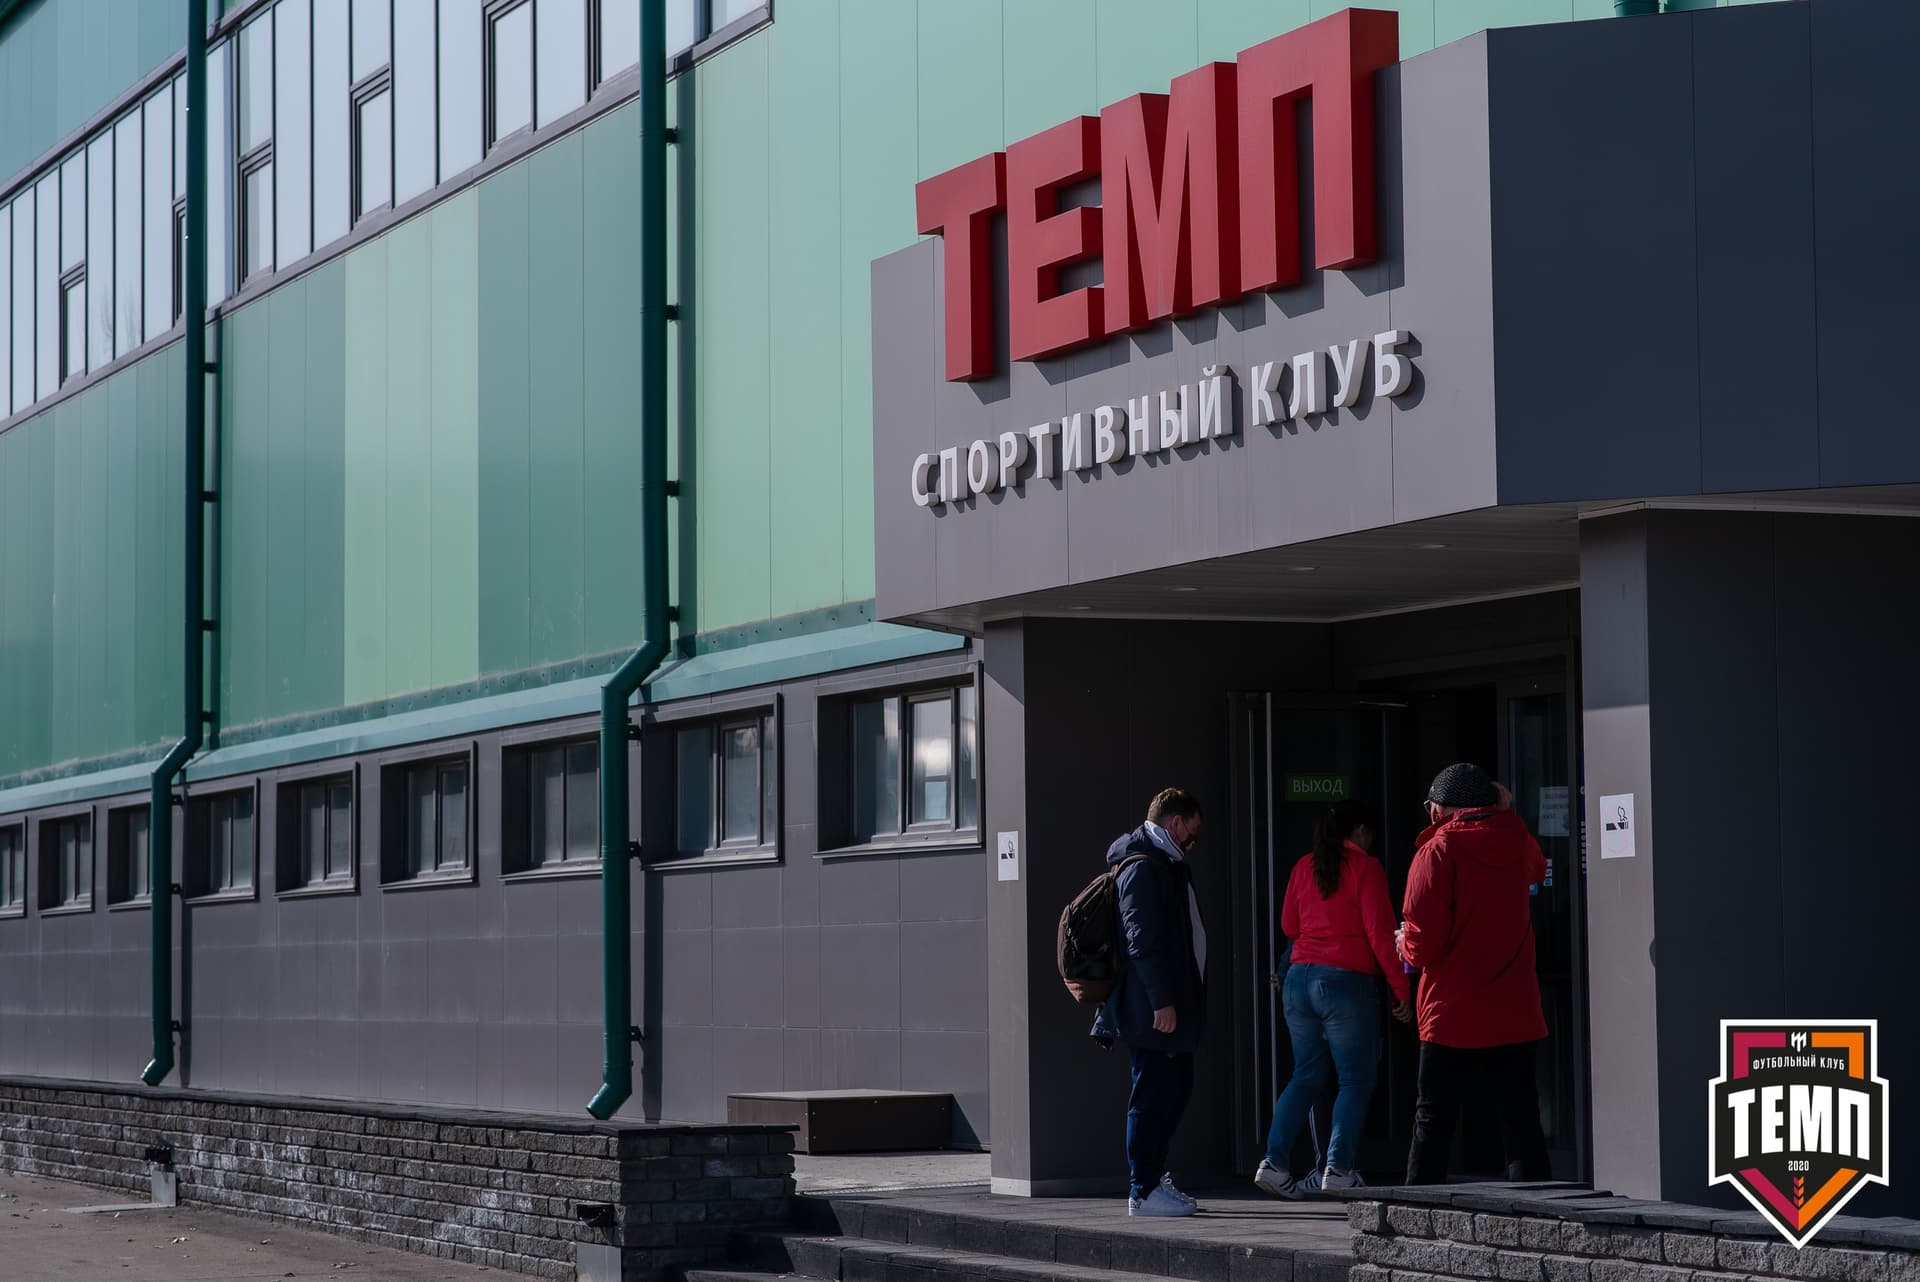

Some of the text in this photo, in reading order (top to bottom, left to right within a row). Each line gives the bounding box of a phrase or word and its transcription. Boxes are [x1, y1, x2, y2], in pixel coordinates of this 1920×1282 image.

[916, 8, 1399, 382] ТЕМП
[911, 330, 1413, 507] СПОРТИВНЫЙ КЛУБ
[1293, 779, 1343, 795] ВЫХОД
